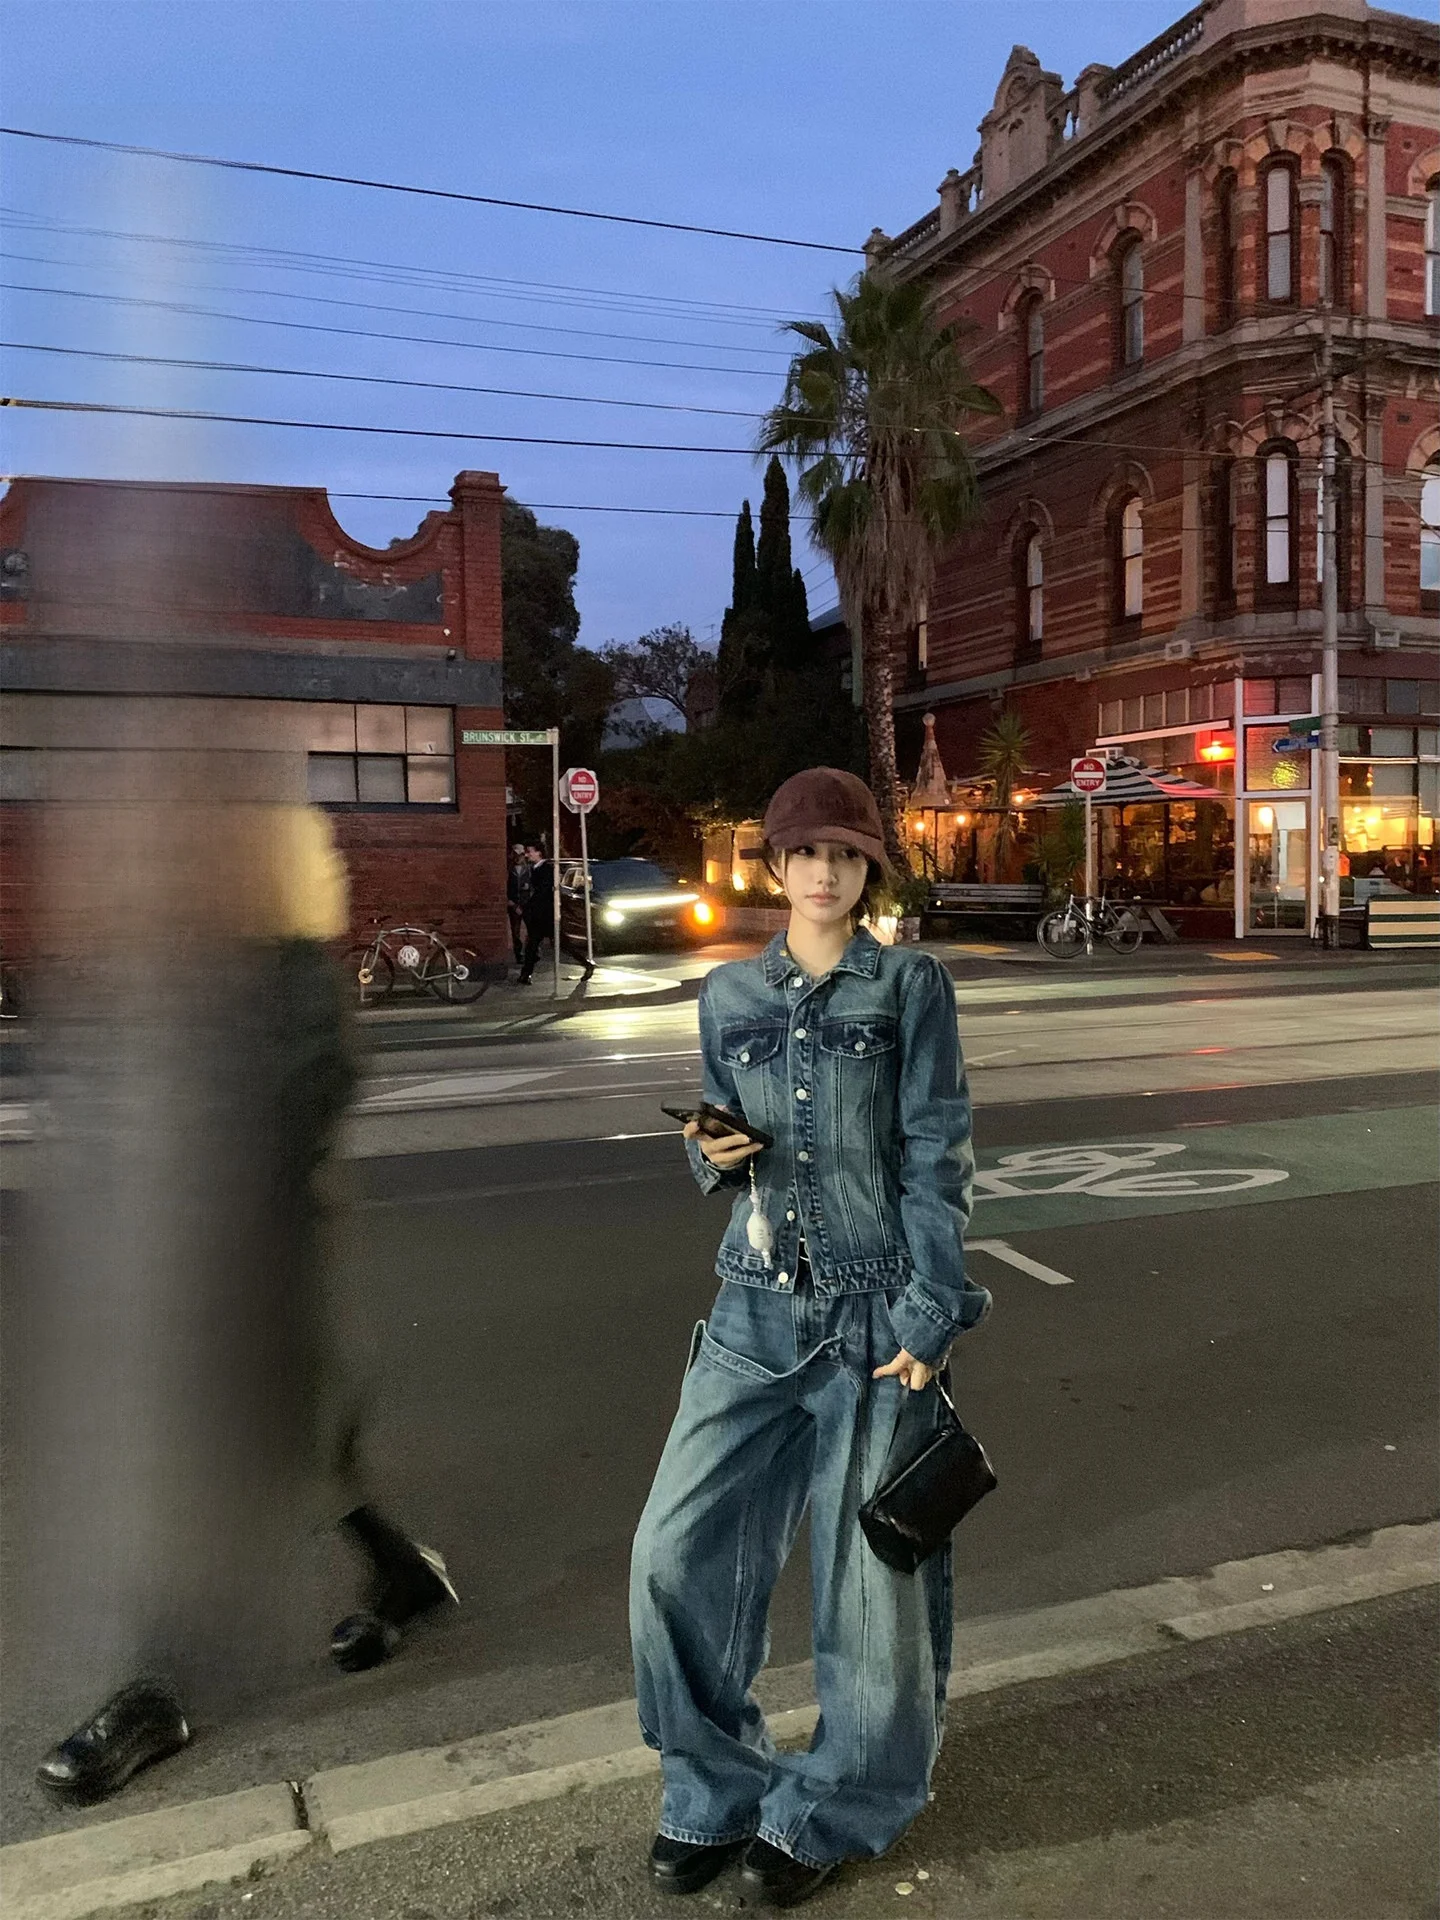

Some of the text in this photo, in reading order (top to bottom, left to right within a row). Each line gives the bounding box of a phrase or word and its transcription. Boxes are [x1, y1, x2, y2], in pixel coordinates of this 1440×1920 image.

[463, 731, 515, 743] BRUNSWICK
[1083, 763, 1095, 771] NO
[1076, 779, 1100, 787] ENTRY
